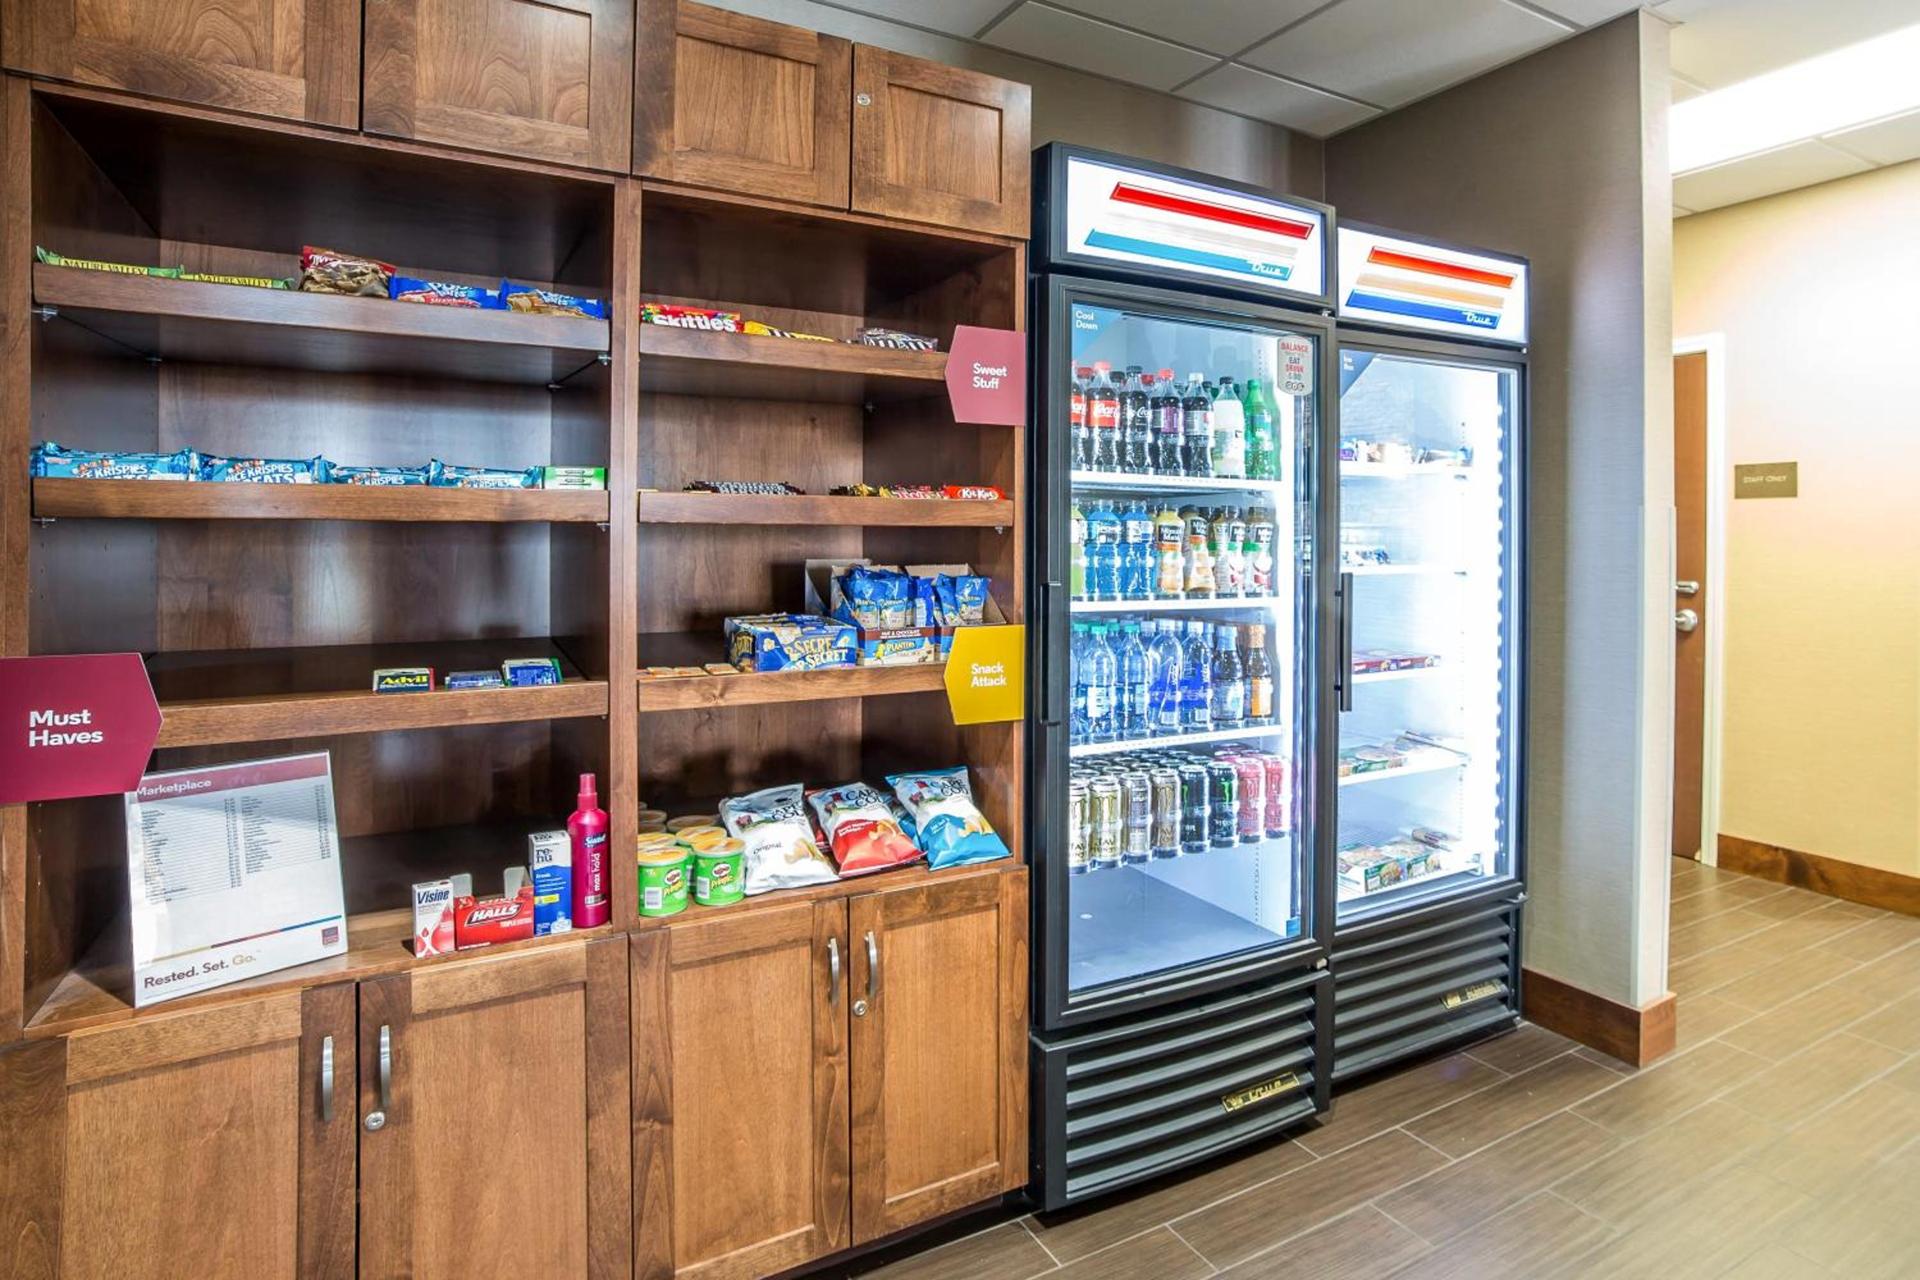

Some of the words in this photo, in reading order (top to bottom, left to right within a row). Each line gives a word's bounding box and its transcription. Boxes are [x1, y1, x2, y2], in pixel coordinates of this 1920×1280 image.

[653, 313, 737, 333] Skittles
[1075, 310, 1094, 321] Cool
[1462, 310, 1493, 325] True
[1075, 320, 1098, 330] Down
[973, 362, 1007, 377] Sweet
[973, 376, 999, 389] Stuff
[94, 463, 148, 479] KRISPIES
[247, 463, 294, 478] KRISPIES
[971, 662, 1004, 675] Snack
[383, 673, 429, 685] Advil
[971, 675, 1007, 687] Attack
[29, 709, 91, 728] Must
[29, 730, 104, 748] Haves
[138, 780, 212, 797] Marketplace
[417, 889, 450, 904] Visine
[471, 904, 520, 923] HALLS
[144, 966, 199, 988] Rested.
[202, 960, 229, 974] Set.
[232, 954, 256, 966] Go.
